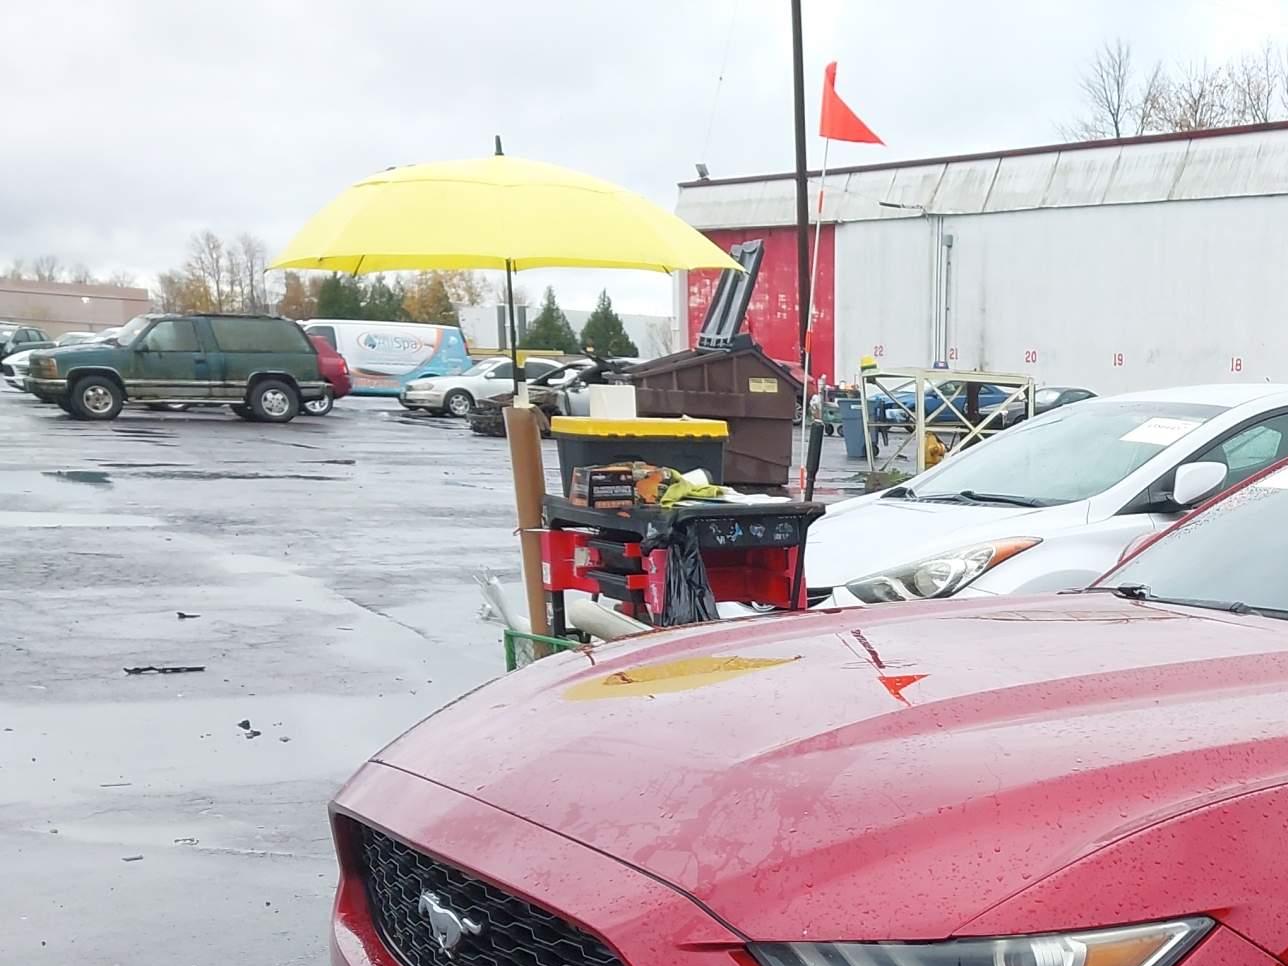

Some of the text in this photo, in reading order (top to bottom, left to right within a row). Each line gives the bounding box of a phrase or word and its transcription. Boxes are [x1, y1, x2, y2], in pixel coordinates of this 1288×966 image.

[873, 345, 884, 357] 22
[949, 348, 959, 360] 21
[1024, 350, 1037, 364] 20
[1113, 353, 1124, 367] 19
[1230, 357, 1243, 372] 18
